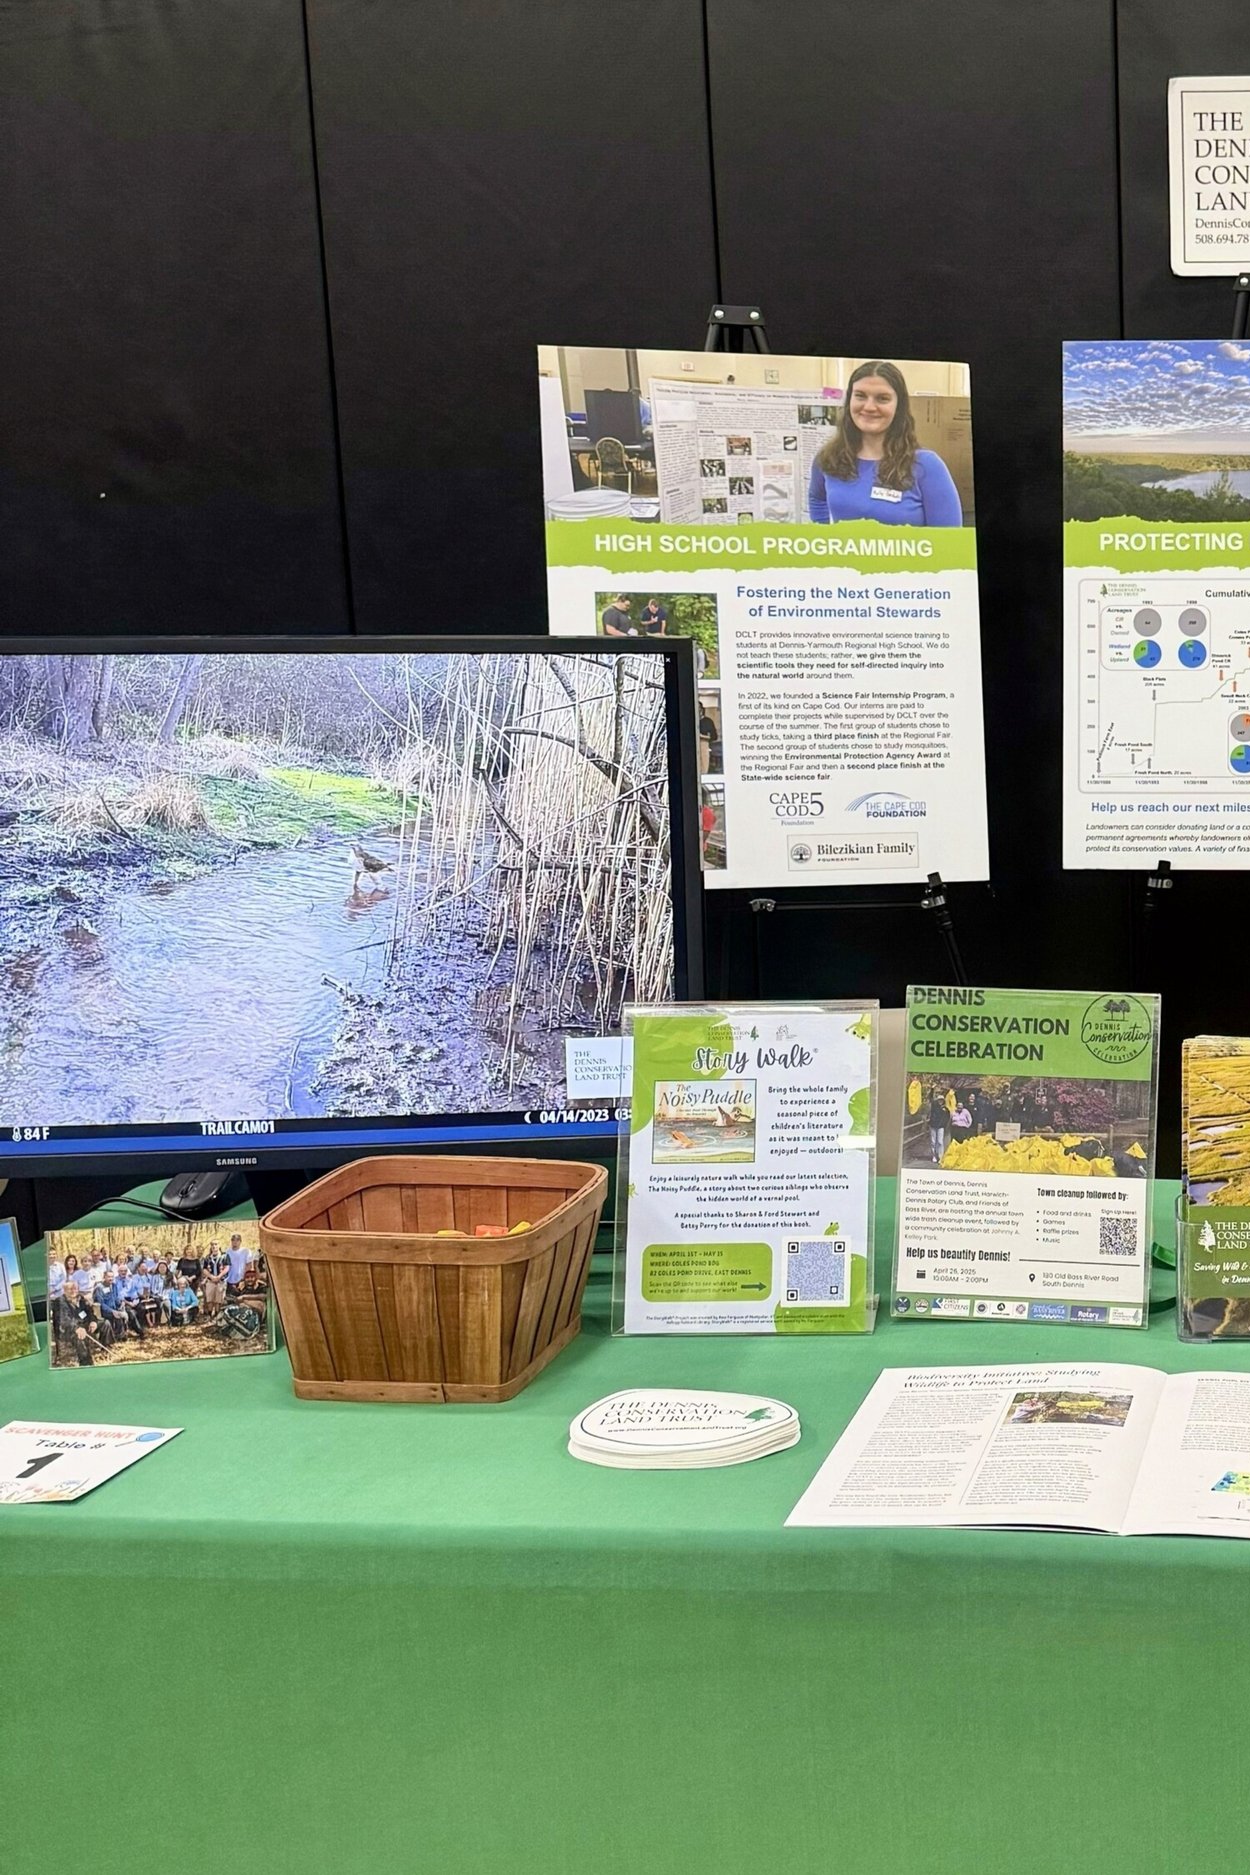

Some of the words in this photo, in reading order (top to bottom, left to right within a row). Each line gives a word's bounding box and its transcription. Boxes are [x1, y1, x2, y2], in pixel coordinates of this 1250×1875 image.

[1194, 112, 1243, 131] THE
[595, 534, 652, 552] HIGH
[659, 535, 755, 554] SCHOOL
[763, 538, 932, 557] PROGRAMMING
[1100, 532, 1242, 551] PROTECTING
[737, 586, 805, 601] Fostering
[811, 588, 832, 598] the
[837, 587, 869, 599] Next
[874, 588, 950, 599] Generation
[749, 605, 764, 617] of
[768, 606, 871, 617] Environmental
[876, 607, 941, 618] Stewards
[770, 792, 808, 804] CAPE
[776, 805, 808, 816] COD
[810, 792, 824, 816] 5
[1091, 802, 1117, 814] Help
[1121, 804, 1134, 812] us
[1138, 802, 1168, 812] reach
[1173, 803, 1191, 812] our
[1195, 803, 1219, 812] next
[818, 845, 873, 855] Bilezikian
[877, 843, 915, 856] Family
[914, 987, 985, 1006] DENNIS
[912, 1014, 1070, 1035] CONSERVATION
[1081, 1022, 1152, 1043] Conservation
[911, 1041, 1044, 1061] CELEBRATION
[692, 1047, 749, 1073] Story
[676, 1084, 691, 1092] The
[768, 1086, 786, 1094] Bring
[826, 1085, 848, 1093] family
[659, 1091, 702, 1107] Noisy
[702, 1088, 751, 1105] Puddle
[540, 1109, 609, 1124] 04/14/2023
[24, 1128, 41, 1140] 84
[43, 1127, 49, 1139] F
[201, 1121, 275, 1135] TRAILCAM01
[1038, 1188, 1055, 1197] Town
[1057, 1190, 1084, 1199] cleanup
[1086, 1190, 1116, 1200] followed
[1118, 1191, 1129, 1201] by:
[1215, 1221, 1237, 1230] THE
[1217, 1241, 1247, 1249] LAND
[907, 1247, 925, 1260] Help
[928, 1249, 938, 1259] us
[941, 1249, 976, 1261] beautify
[979, 1250, 1010, 1261] Dennis!
[1194, 1262, 1220, 1273] Saving
[1223, 1262, 1240, 1271] Wild
[1222, 1276, 1229, 1284] in
[610, 1402, 642, 1410] THE
[604, 1409, 748, 1417] CONSERVATION
[600, 1417, 651, 1425] LAND
[4, 1427, 92, 1438] SCAVENGER
[94, 1430, 135, 1439] HUNT
[35, 1439, 86, 1449] Table
[16, 1453, 64, 1478] 1
